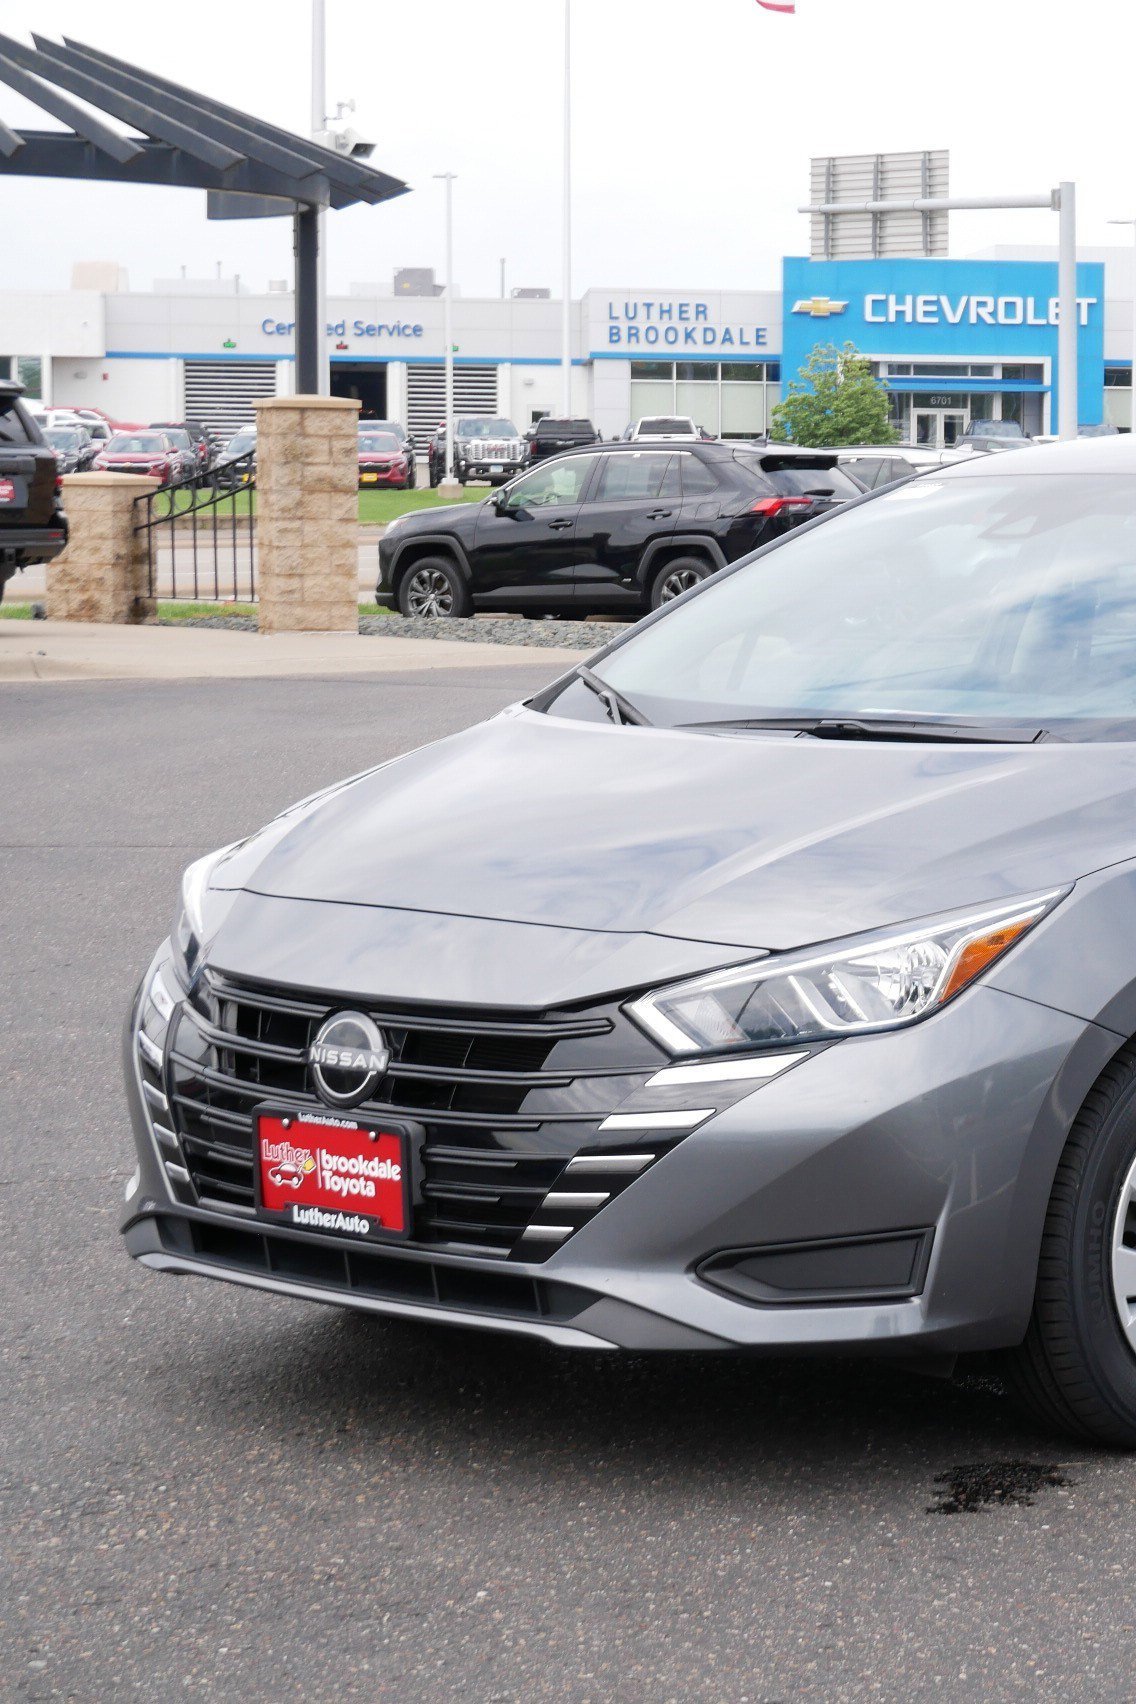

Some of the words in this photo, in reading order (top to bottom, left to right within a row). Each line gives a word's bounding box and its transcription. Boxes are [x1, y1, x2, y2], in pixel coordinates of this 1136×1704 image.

[608, 302, 708, 321] LUTHER
[864, 293, 1097, 326] CHEVROLET
[353, 320, 424, 338] Service
[608, 326, 767, 346] BROOKDALE
[930, 396, 952, 404] 6701
[310, 1046, 386, 1070] NISSAN
[297, 1112, 358, 1130] LutherAuto.com
[261, 1138, 312, 1163] Luther
[321, 1149, 401, 1181] brookdale
[322, 1170, 376, 1197] Toyota
[292, 1204, 370, 1234] LutherAuto
